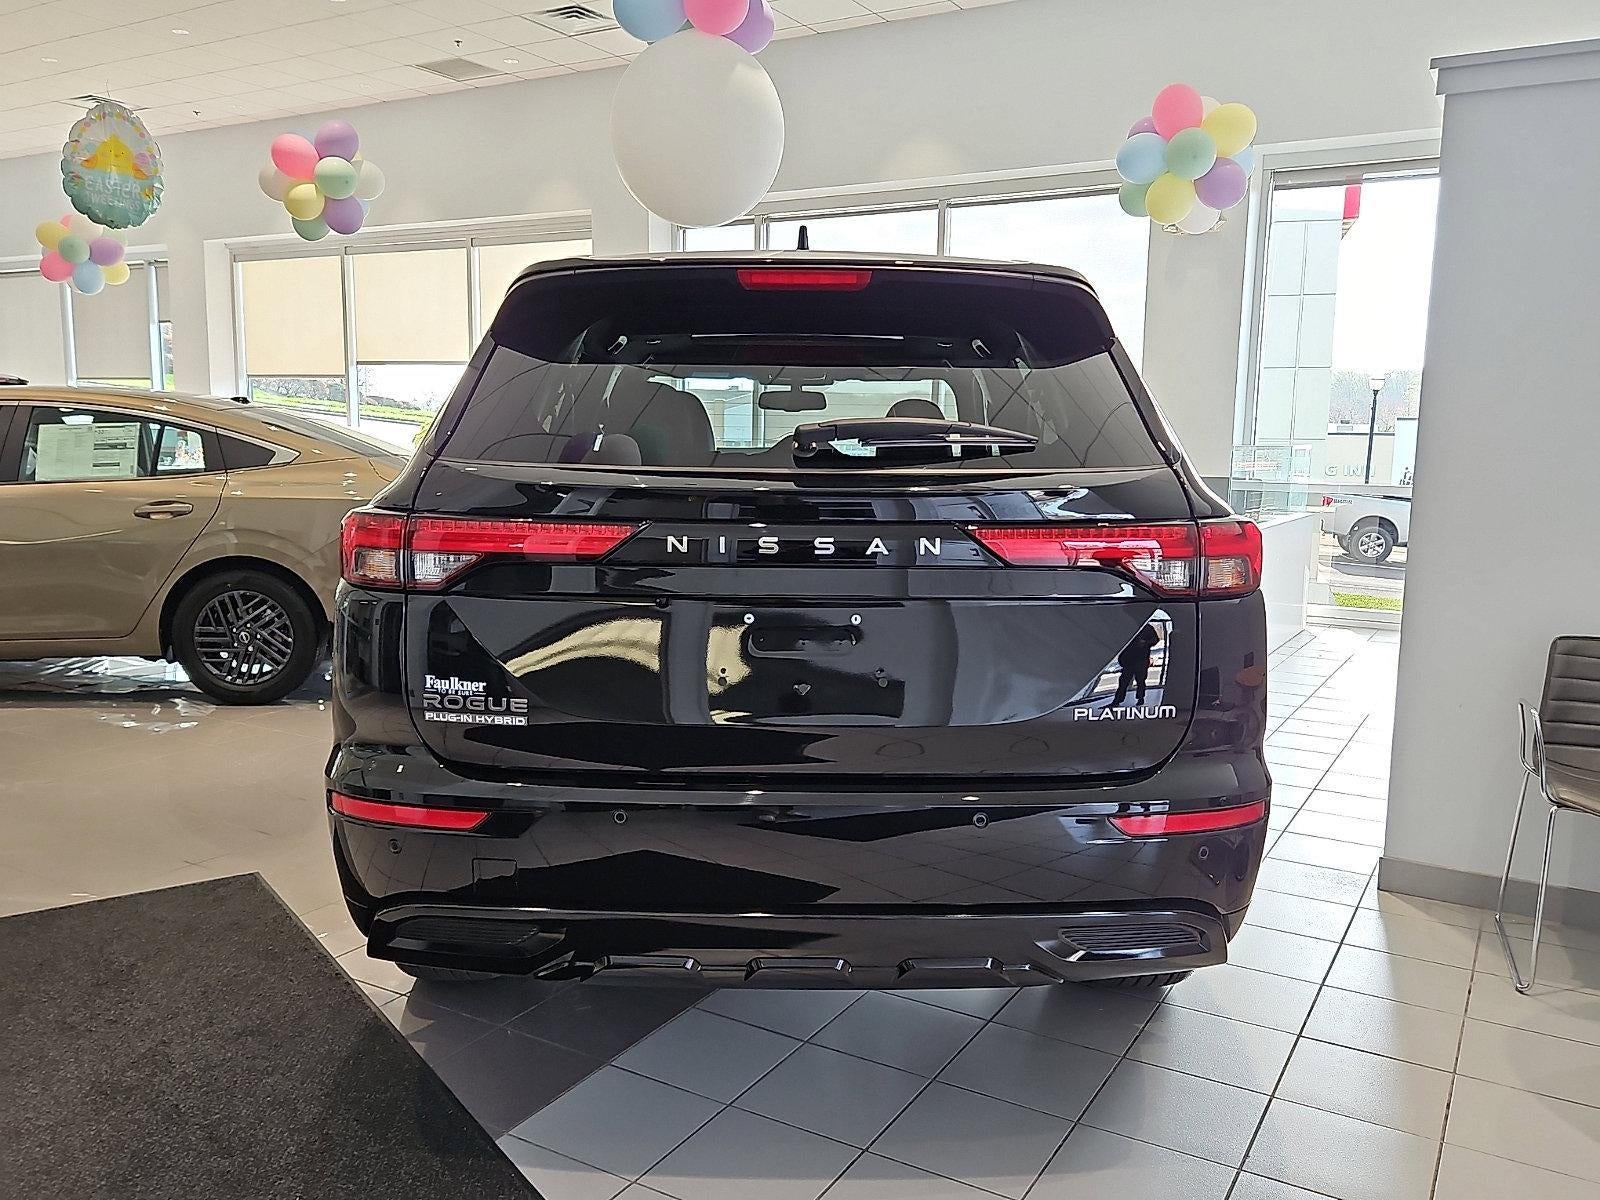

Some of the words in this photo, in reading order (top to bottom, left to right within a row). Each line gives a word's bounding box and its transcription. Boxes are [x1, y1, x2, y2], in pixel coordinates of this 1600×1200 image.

[666, 535, 942, 556] NISSAN
[425, 674, 487, 692] Faulkner
[423, 693, 528, 713] ROGUE
[424, 712, 472, 723] PLUG-IN
[475, 715, 528, 726] HYBRID
[1073, 705, 1177, 721] PLATINUM
